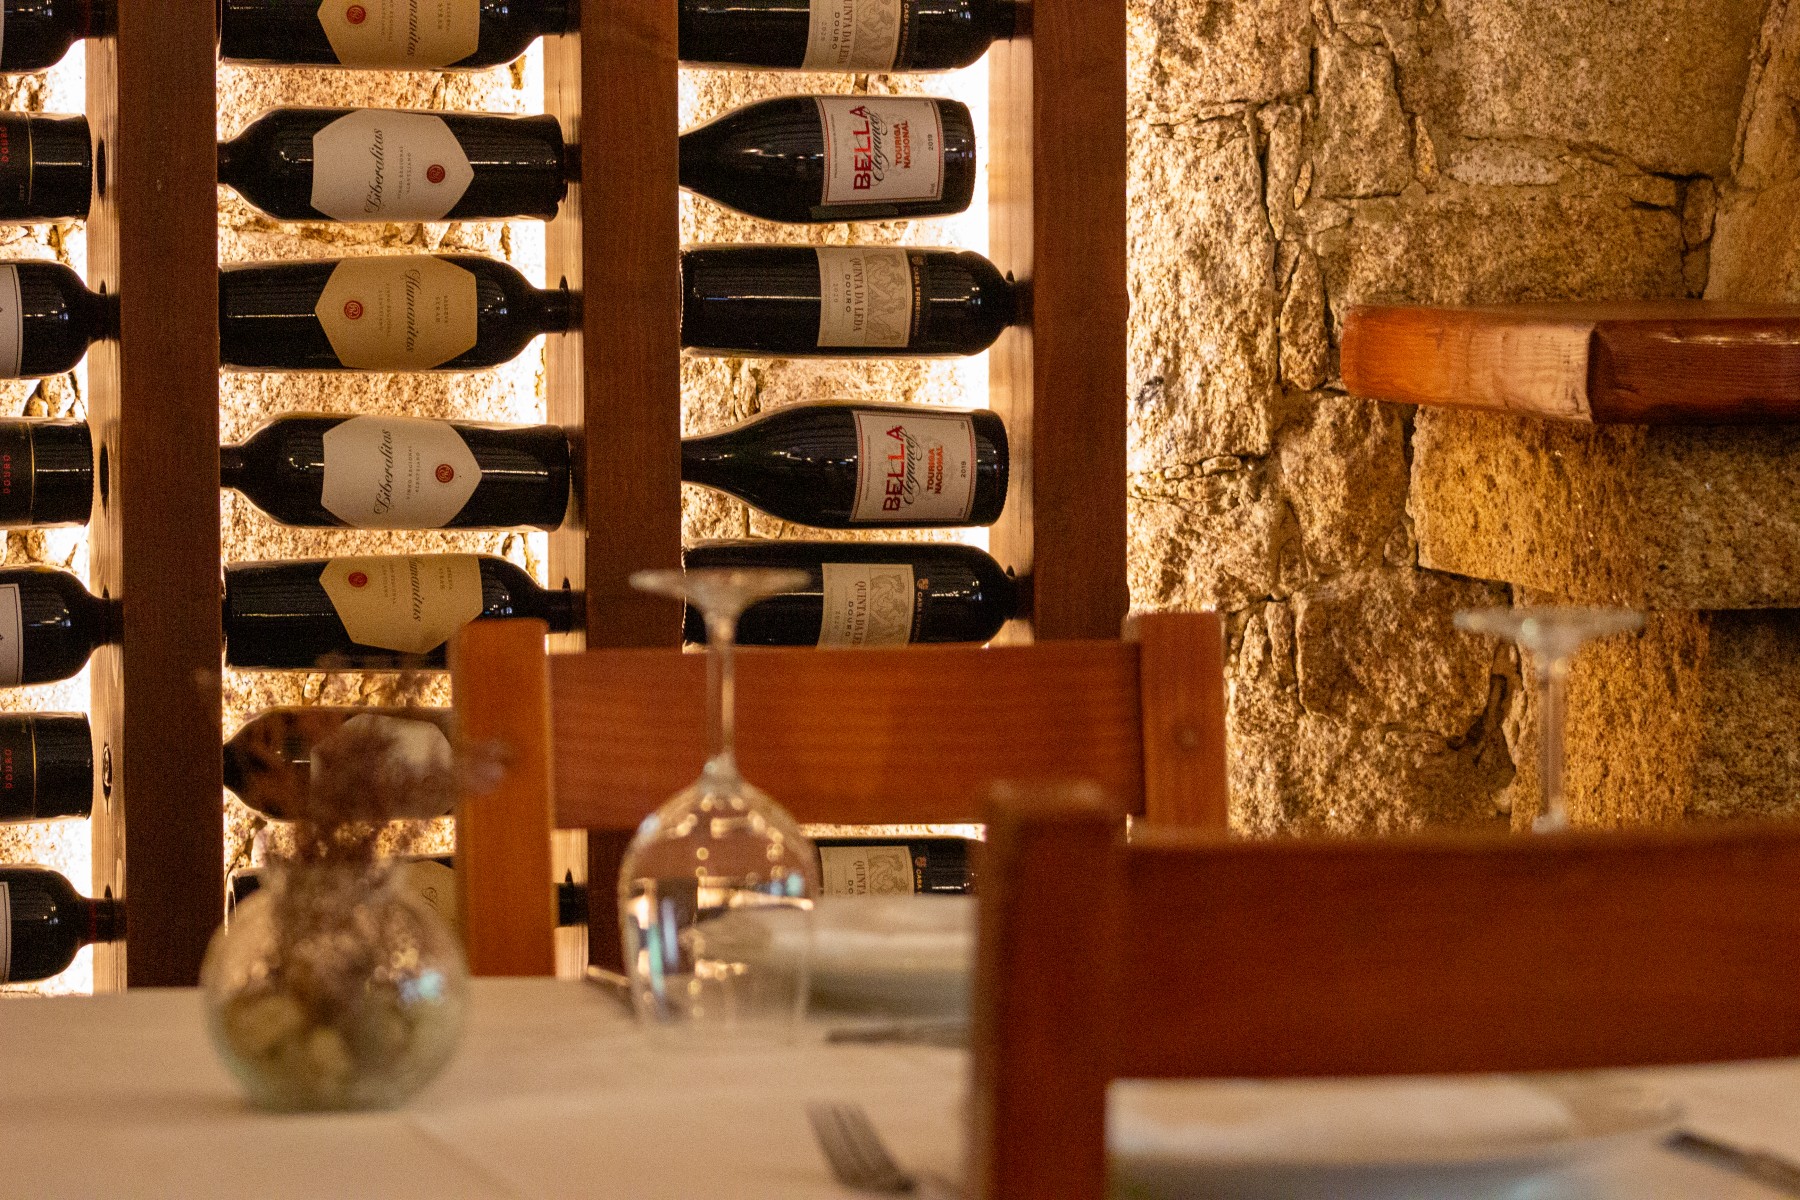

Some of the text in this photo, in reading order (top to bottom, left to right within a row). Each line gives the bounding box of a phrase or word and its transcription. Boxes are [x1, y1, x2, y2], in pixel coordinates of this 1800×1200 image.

[407, 0, 420, 57] manitas
[832, 11, 840, 50] DOURO
[841, 31, 852, 44] DA
[849, 105, 872, 190] BELLA
[893, 123, 902, 166] TOURIGA
[900, 120, 911, 169] NACIONAL
[363, 128, 385, 213] Liberalitas
[404, 268, 421, 353] Humanitas
[850, 258, 864, 332] QUINTA DA LEDA
[3, 454, 11, 495] DOURO
[373, 429, 394, 515] Liberalitas
[882, 425, 905, 511] BELLA
[926, 447, 935, 491] TOURIGA
[934, 445, 944, 494] NACIONAL
[845, 601, 854, 637] DOURO
[855, 580, 867, 618] QUINTA
[854, 620, 865, 632] DA
[4, 748, 13, 789] DOURO
[853, 860, 867, 895] QUINTA
